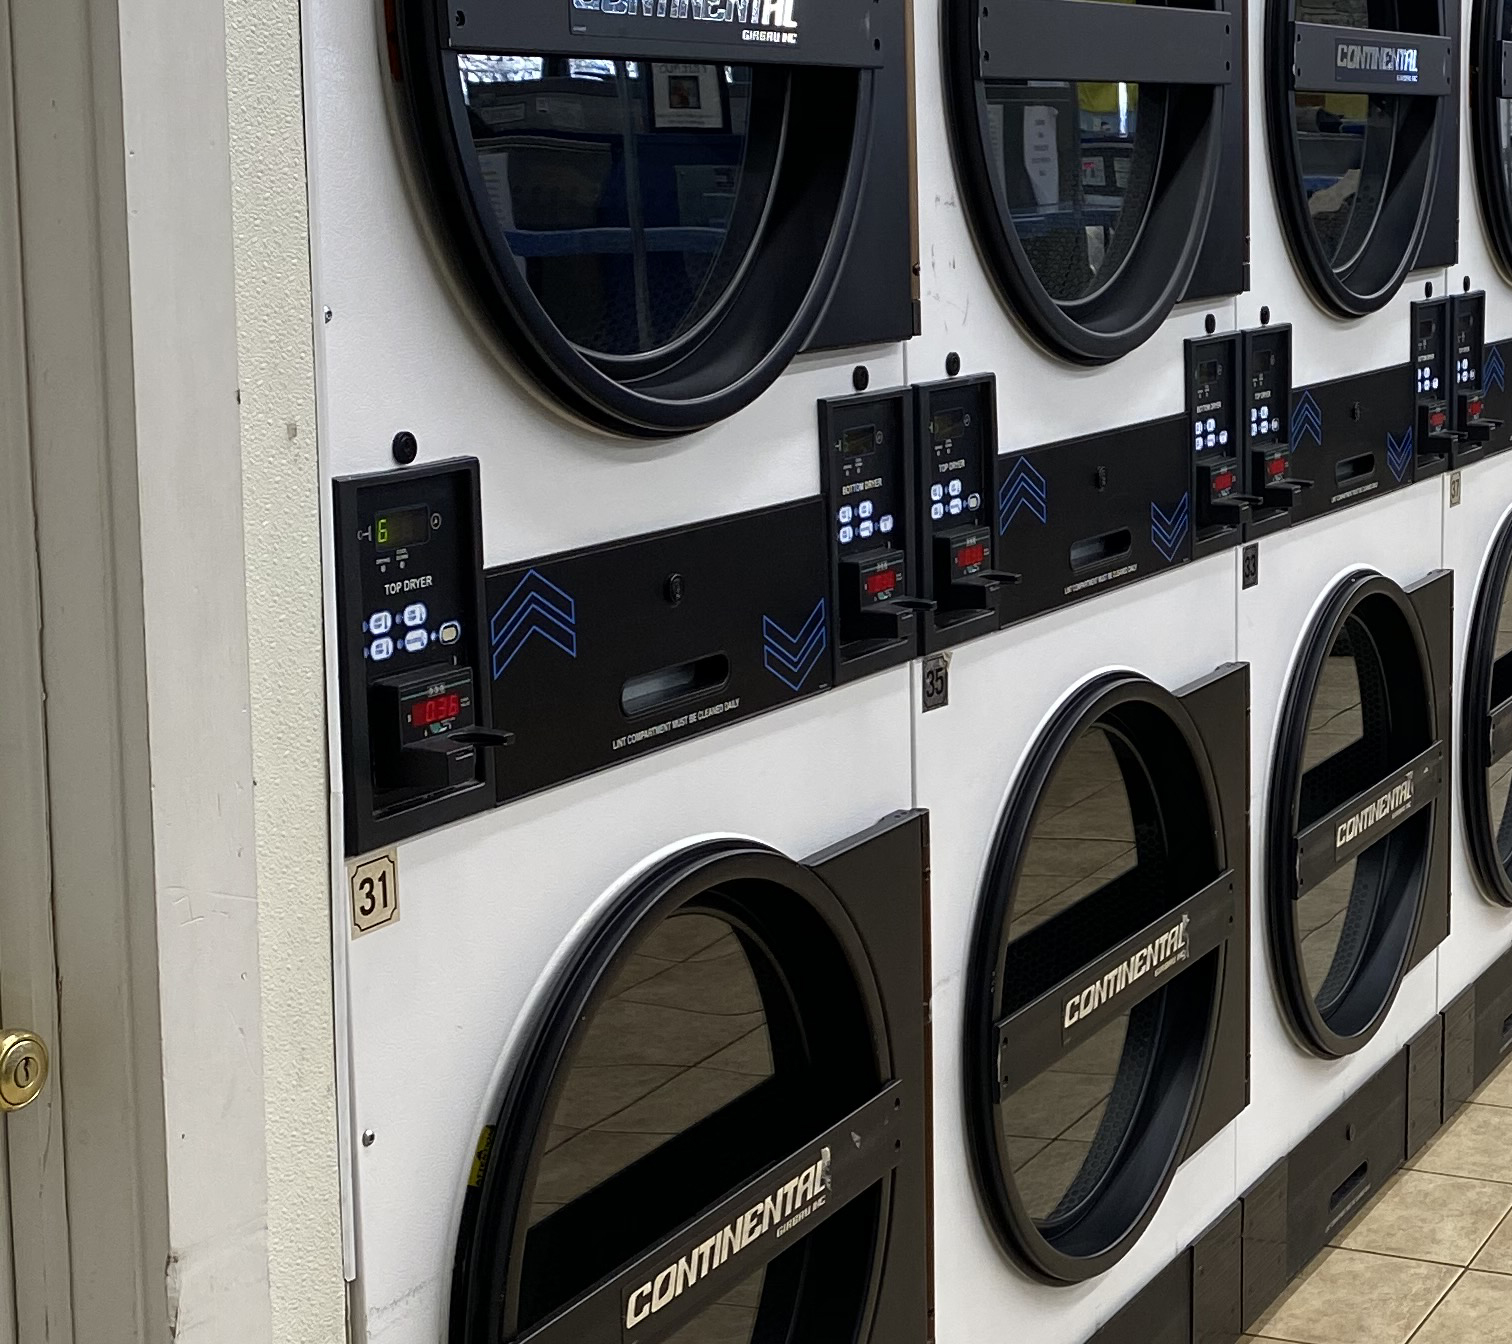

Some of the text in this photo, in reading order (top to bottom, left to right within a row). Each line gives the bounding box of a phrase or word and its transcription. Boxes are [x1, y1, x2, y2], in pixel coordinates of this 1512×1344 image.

[1336, 43, 1419, 73] CONTINENTAL
[1450, 479, 1461, 498] 37
[384, 574, 433, 596] TOP DRYER
[926, 667, 944, 697] 35
[612, 697, 741, 751] LINT COMPARTMENT MUST BE CLEANED DAILY
[1336, 778, 1412, 848] CONTINENTAL
[358, 870, 388, 916] 31
[1064, 921, 1187, 1029] CONTINENTAL
[776, 1203, 812, 1238] GIRBAU
[625, 1156, 830, 1331] CONTINENTAL
